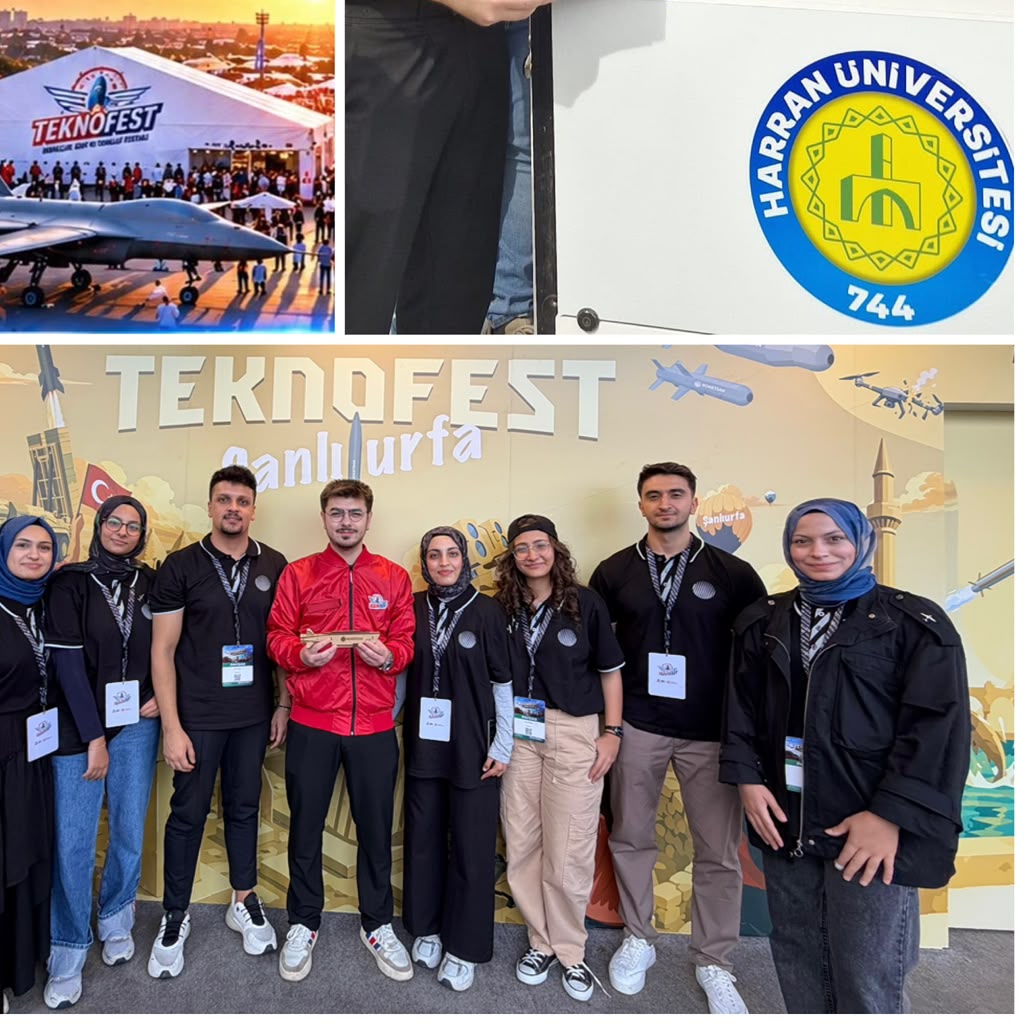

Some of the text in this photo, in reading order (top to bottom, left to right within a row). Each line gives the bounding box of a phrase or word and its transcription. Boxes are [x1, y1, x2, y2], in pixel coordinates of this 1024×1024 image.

[32, 103, 164, 147] TEKNOFEST
[757, 59, 1012, 252] HARRAN ÜNİVERSİTESİ
[847, 284, 916, 320] 744
[105, 355, 616, 442] TEKNOFEST
[702, 510, 746, 528] Şanlıurfa
